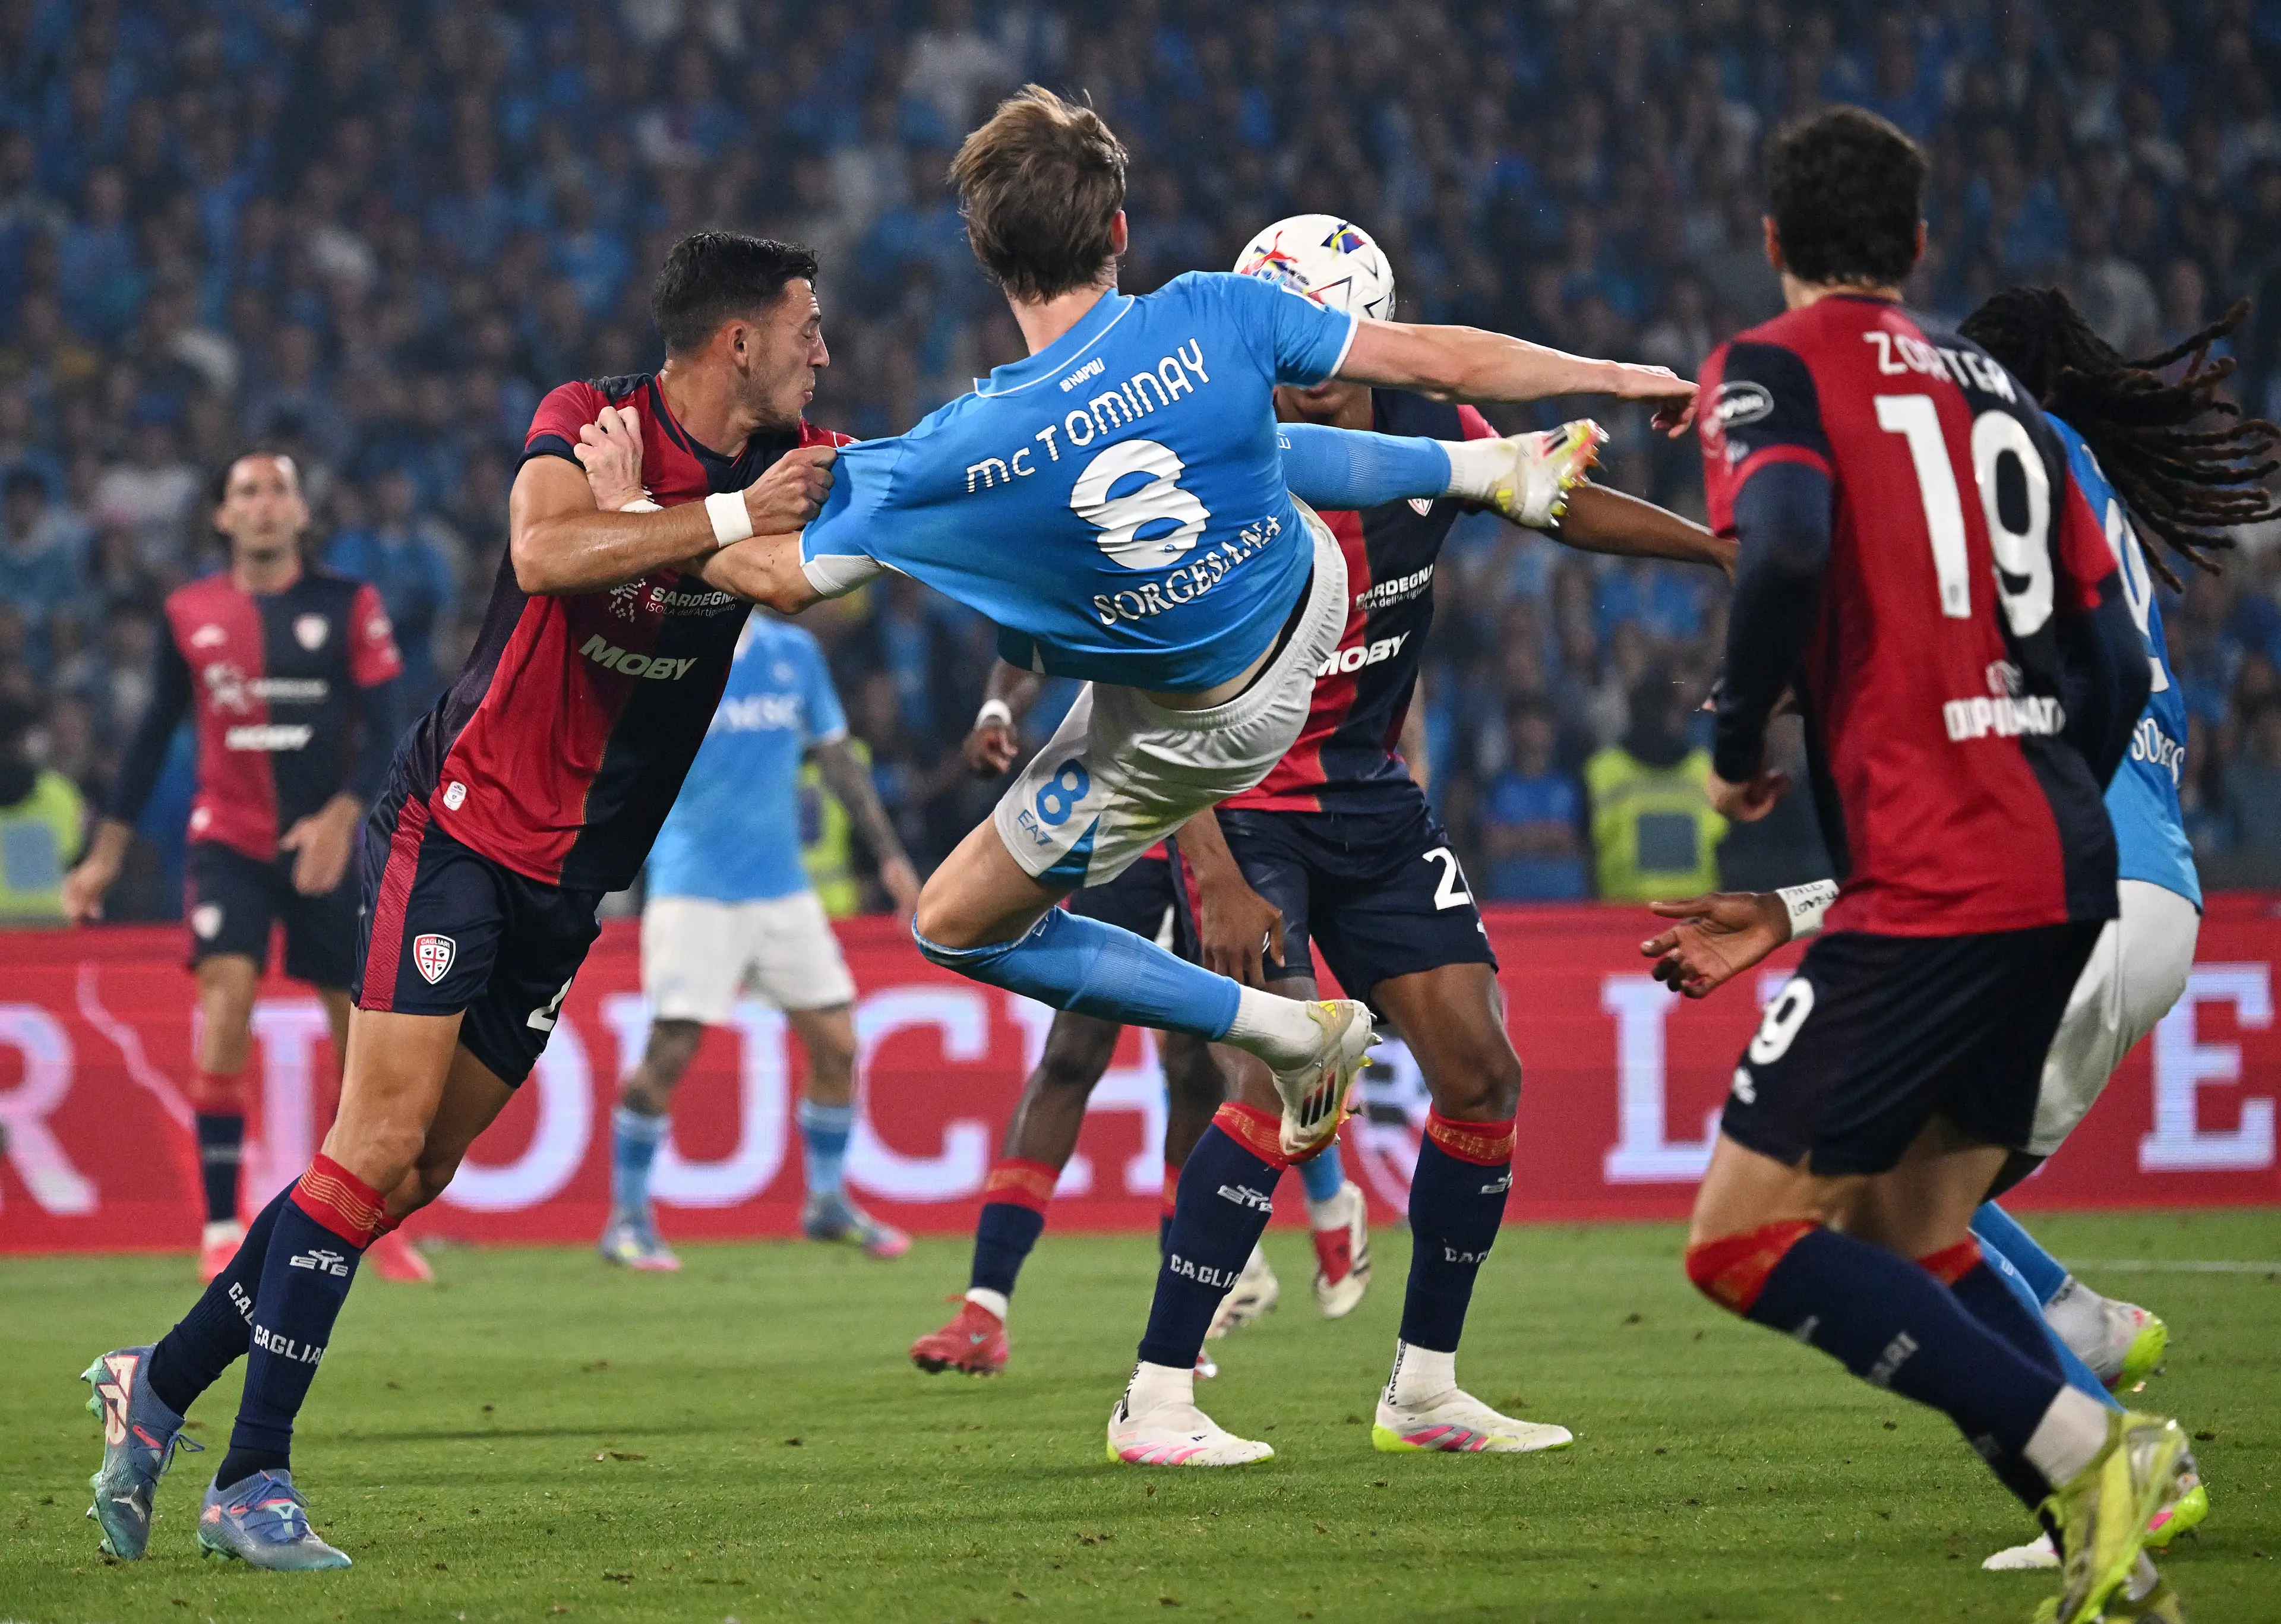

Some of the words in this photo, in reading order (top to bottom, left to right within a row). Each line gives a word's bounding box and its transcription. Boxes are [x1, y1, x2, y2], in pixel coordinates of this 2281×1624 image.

[1070, 439, 1211, 570] 8
[1873, 394, 2054, 637] 19
[650, 586, 738, 607] SARDEGN
[1093, 515, 1282, 625] SORGESANA
[578, 633, 698, 681] MOBY
[1036, 758, 1091, 826] 8
[1018, 808, 1054, 846] EA7
[1421, 846, 1479, 911] 2
[421, 939, 450, 949] CAGLIARI
